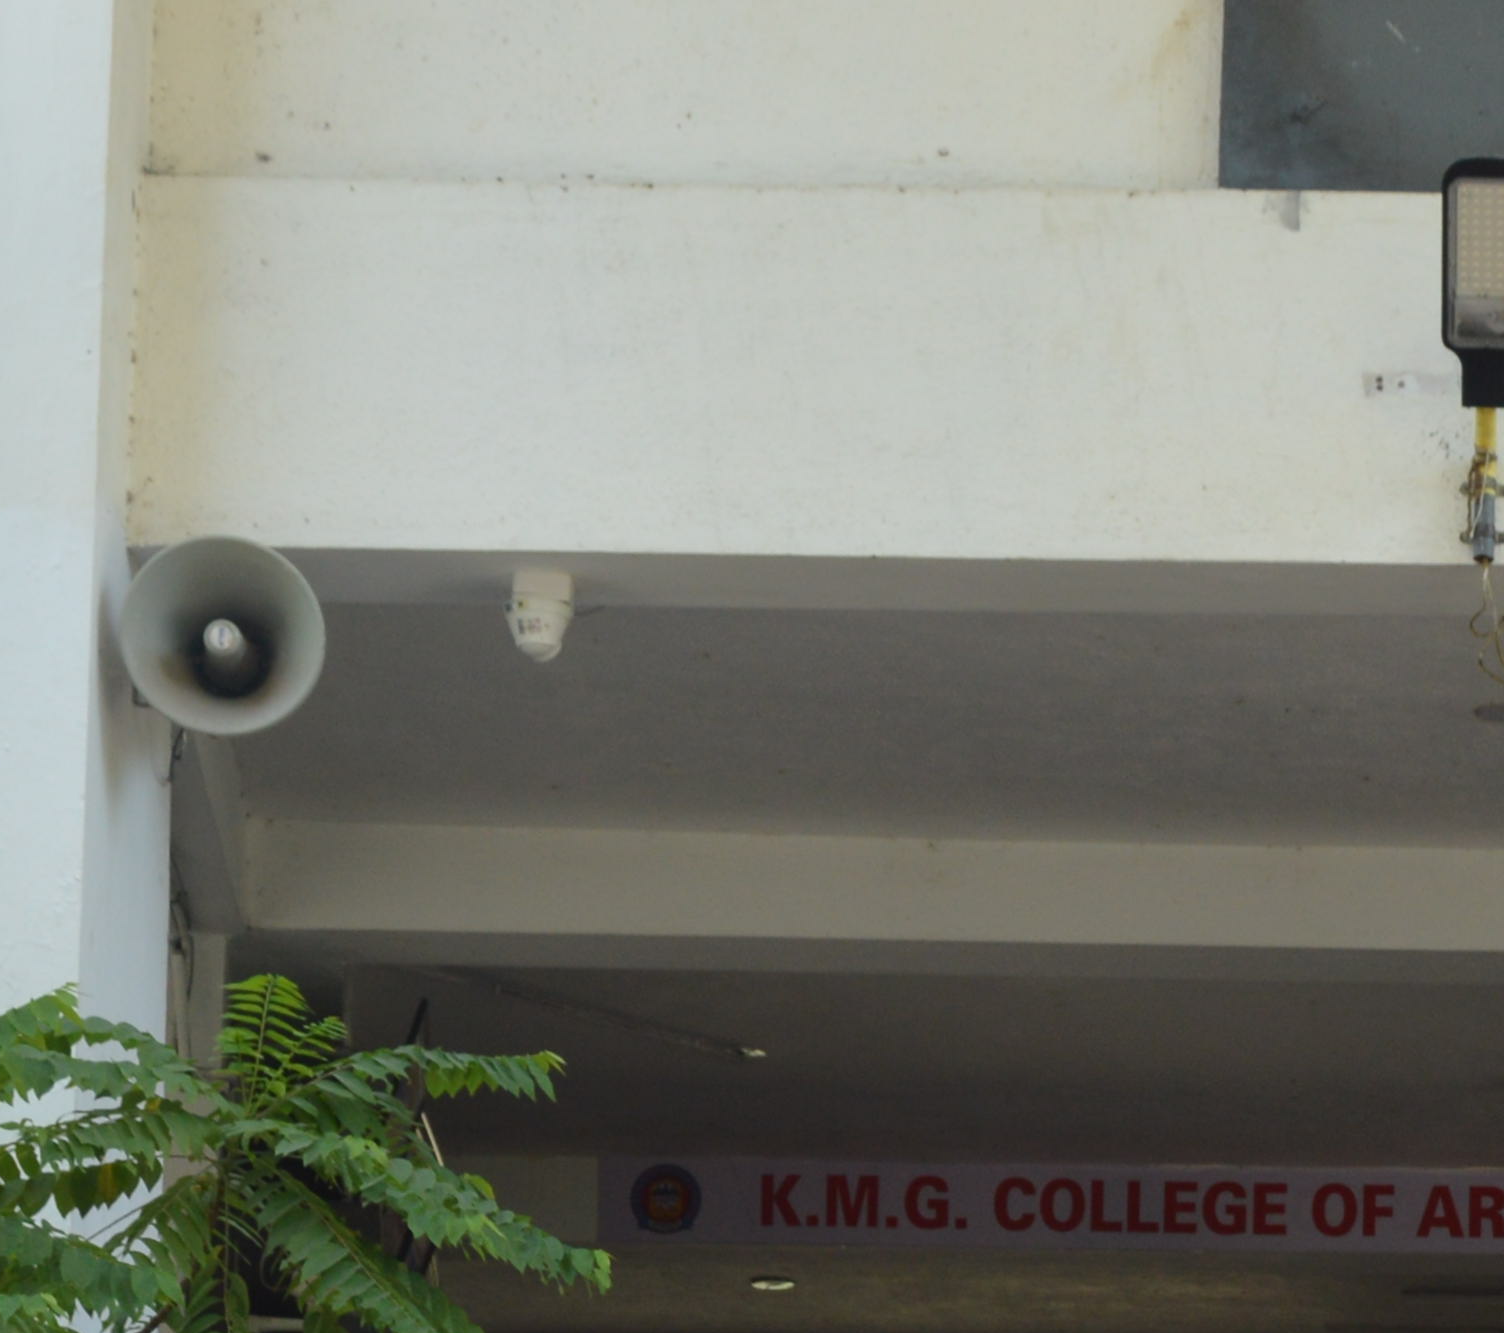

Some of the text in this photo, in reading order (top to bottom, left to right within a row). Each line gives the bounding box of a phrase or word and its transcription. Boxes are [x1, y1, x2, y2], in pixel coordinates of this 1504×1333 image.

[760, 1175, 967, 1229] K.M.G.
[993, 1177, 1287, 1235] COLLEGE
[1311, 1182, 1395, 1237] OF
